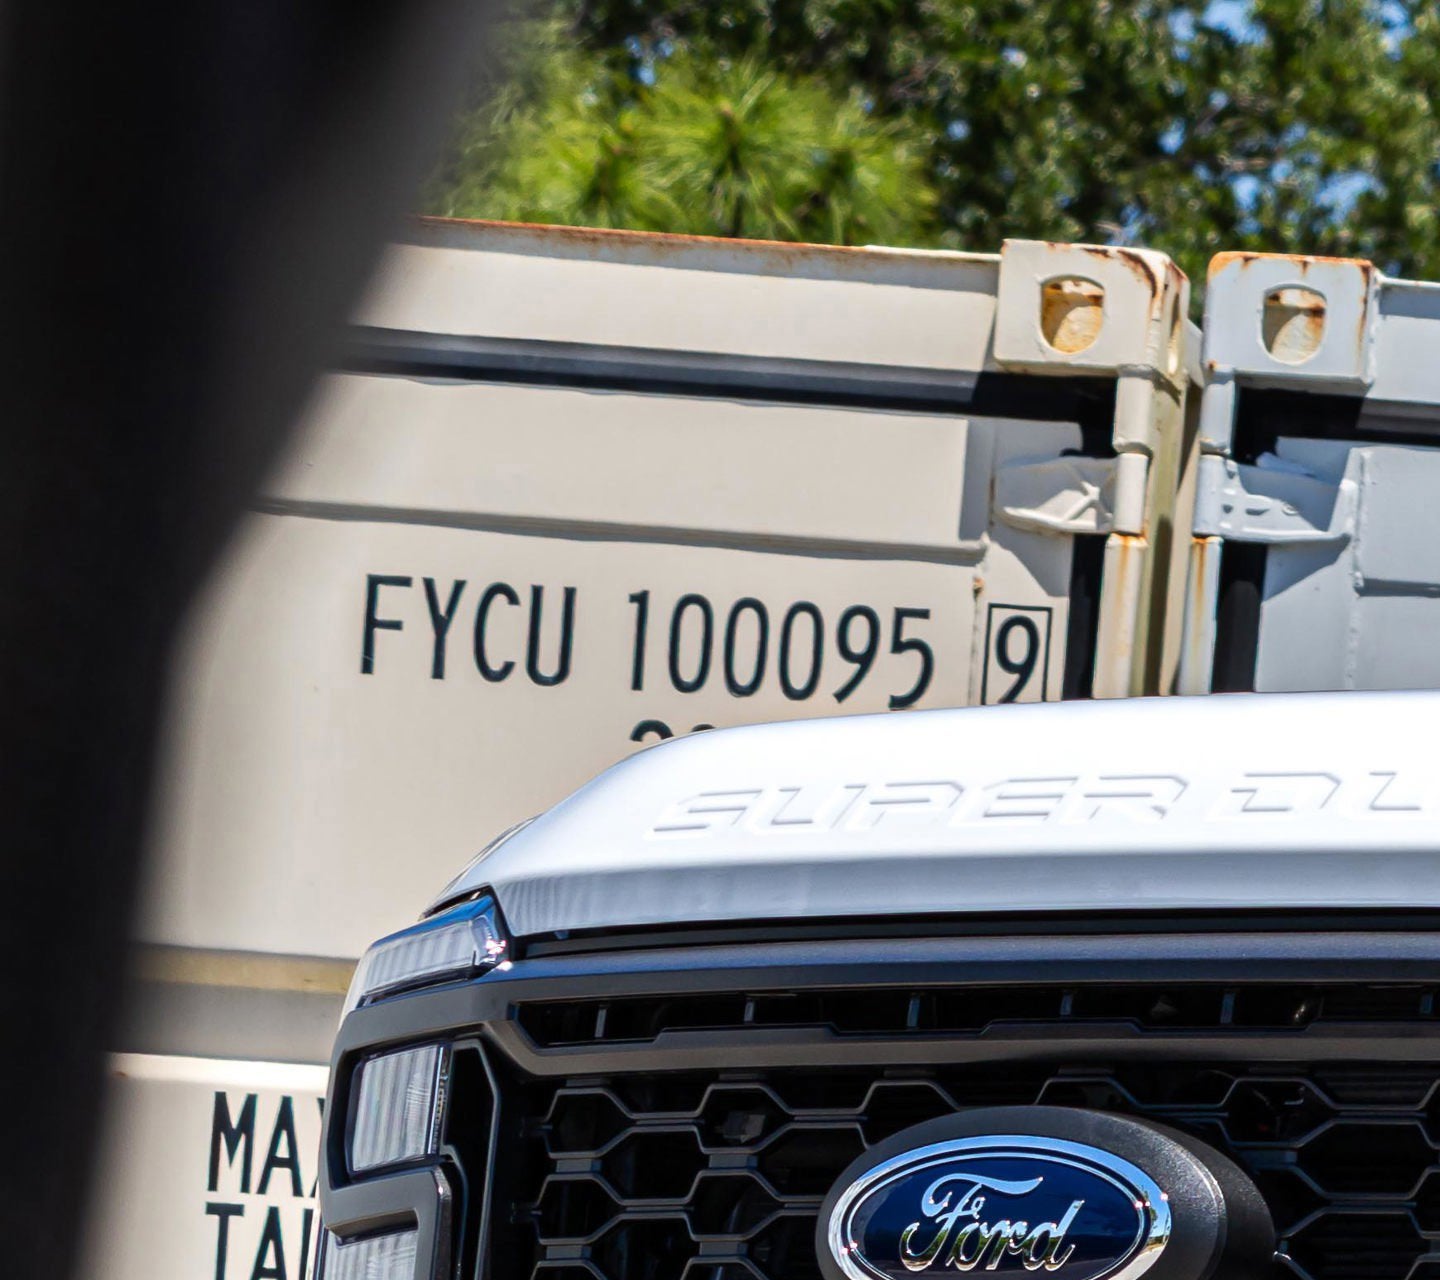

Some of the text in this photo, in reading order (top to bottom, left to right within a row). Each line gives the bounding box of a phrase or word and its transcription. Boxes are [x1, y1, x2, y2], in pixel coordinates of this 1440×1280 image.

[360, 572, 1040, 711] FYCU 100095 9
[648, 774, 1190, 840] SUPER
[207, 1091, 326, 1198] MA
[901, 1172, 1086, 1273] Ford
